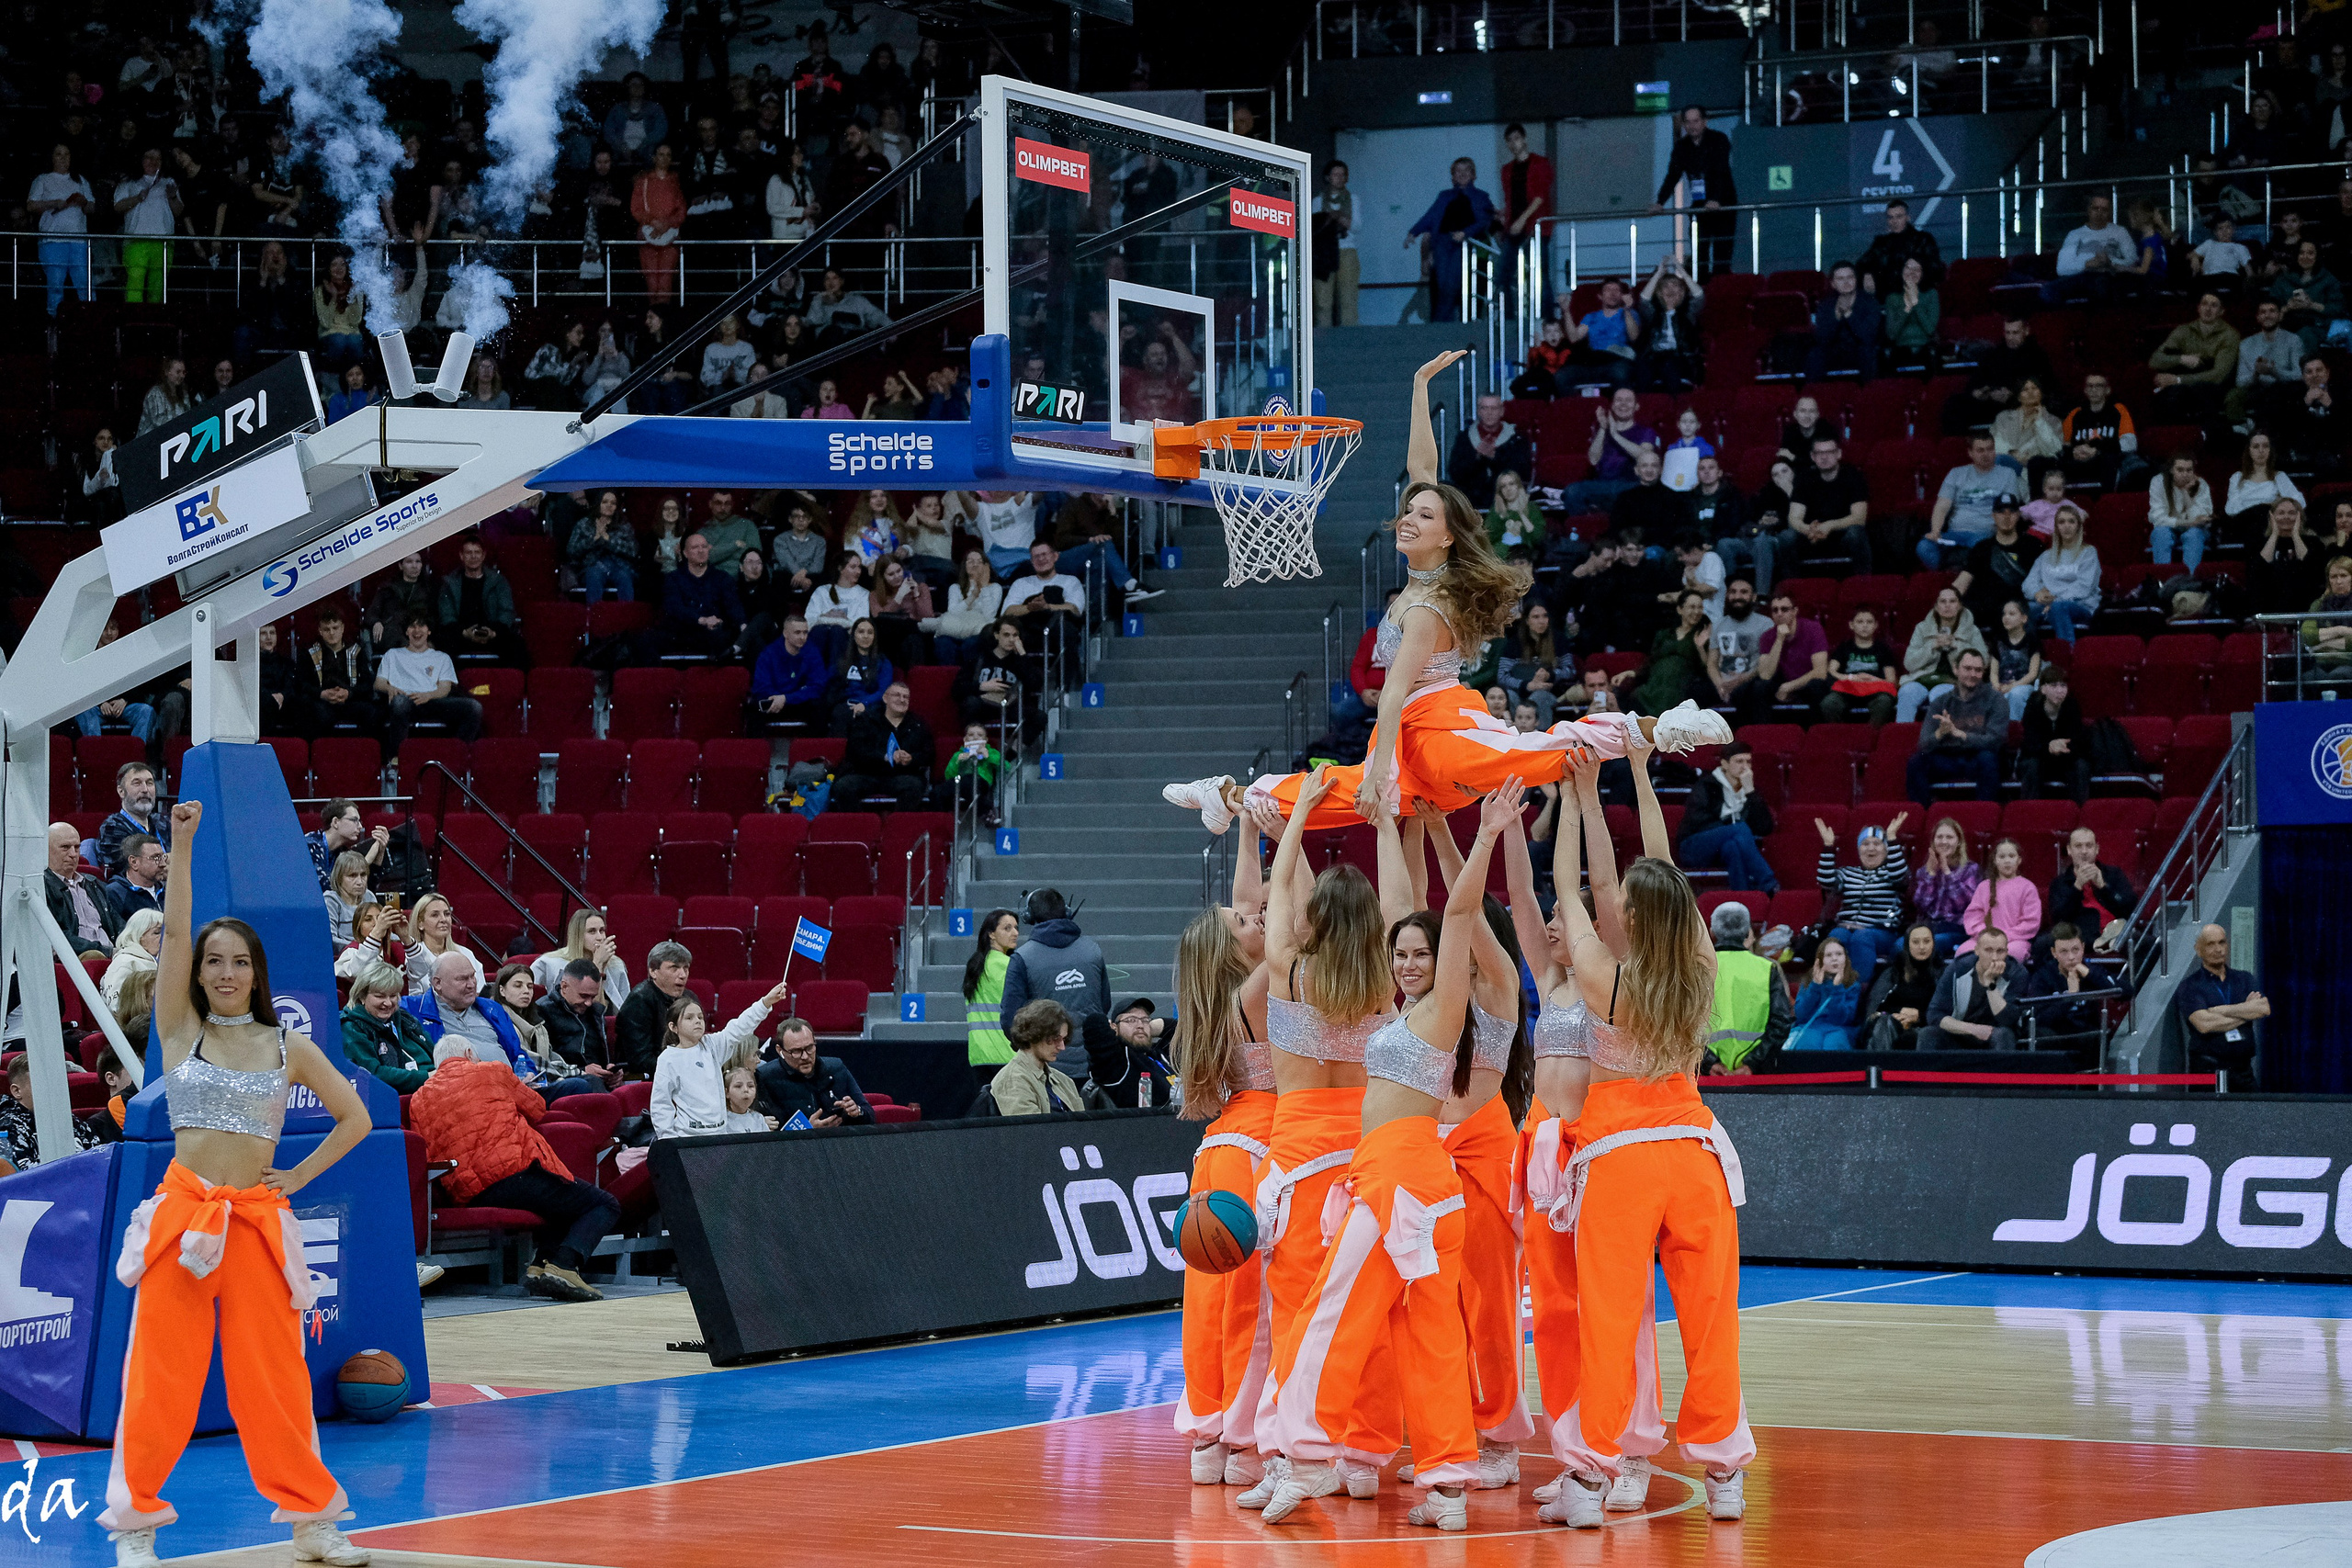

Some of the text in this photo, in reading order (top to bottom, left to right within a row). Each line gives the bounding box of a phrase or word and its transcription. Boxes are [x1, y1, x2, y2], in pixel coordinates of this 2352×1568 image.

[1018, 151, 1086, 180] OLIMPBET
[1872, 130, 1904, 182] 4
[1232, 199, 1292, 227] OLIMPBET
[1016, 382, 1086, 421] PARI
[160, 389, 267, 479] PARI
[829, 432, 933, 452] Schelde
[830, 452, 933, 476] Sports
[396, 518, 417, 533] Superior
[424, 507, 442, 521] Design
[298, 492, 439, 571] Schelde Sports
[1168, 554, 1176, 569] 8
[1129, 618, 1137, 634] 7
[1091, 691, 1098, 705] 6
[1048, 761, 1057, 775] 5
[1002, 835, 1012, 851] 4
[956, 917, 965, 932] 3
[794, 936, 823, 953] ОБЕДИМ!
[909, 1001, 918, 1018] 2
[1992, 1122, 2352, 1249] JÖG
